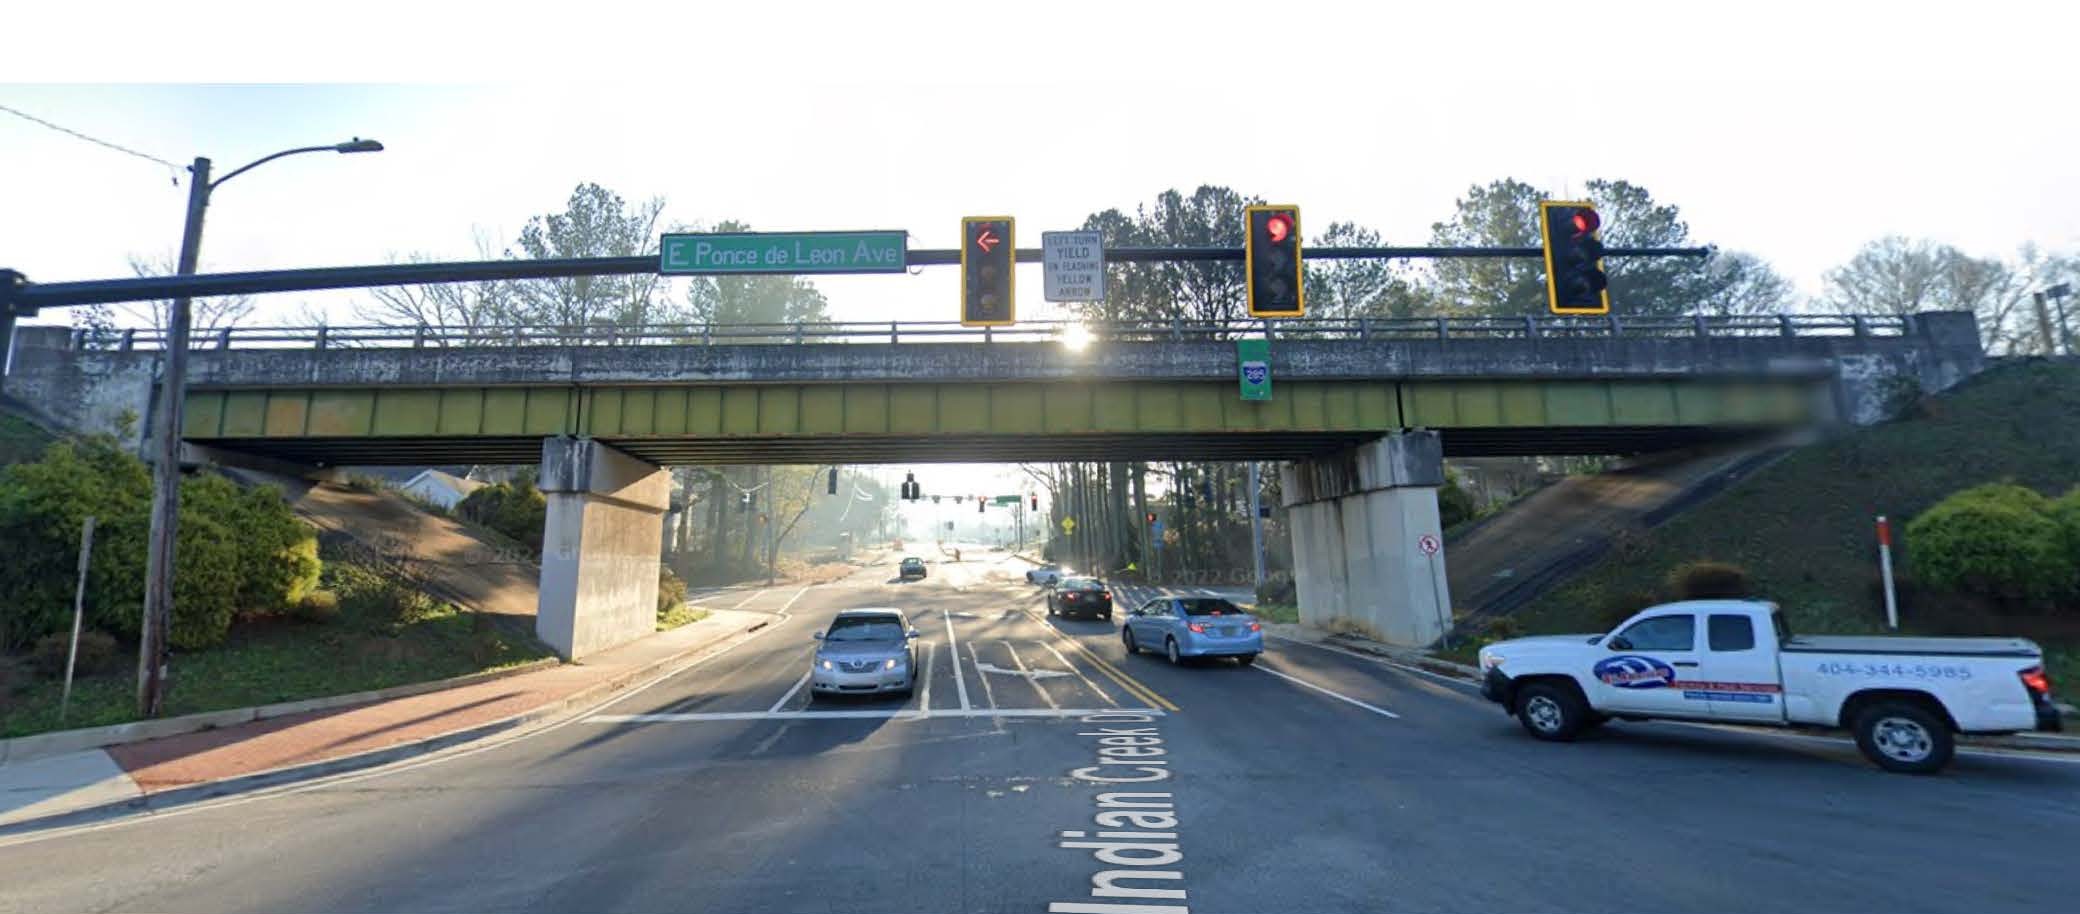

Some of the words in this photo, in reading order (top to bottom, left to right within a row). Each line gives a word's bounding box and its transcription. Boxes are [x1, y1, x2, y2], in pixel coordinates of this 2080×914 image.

[668, 242, 689, 265] E
[695, 241, 758, 265] Ponce
[764, 247, 788, 265] de
[795, 240, 845, 264] Leon
[852, 239, 897, 263] Ave
[1056, 247, 1090, 259] YIELD
[1056, 274, 1092, 285] YELLOW
[1057, 287, 1091, 297] ARROW
[1247, 370, 1265, 380] 285
